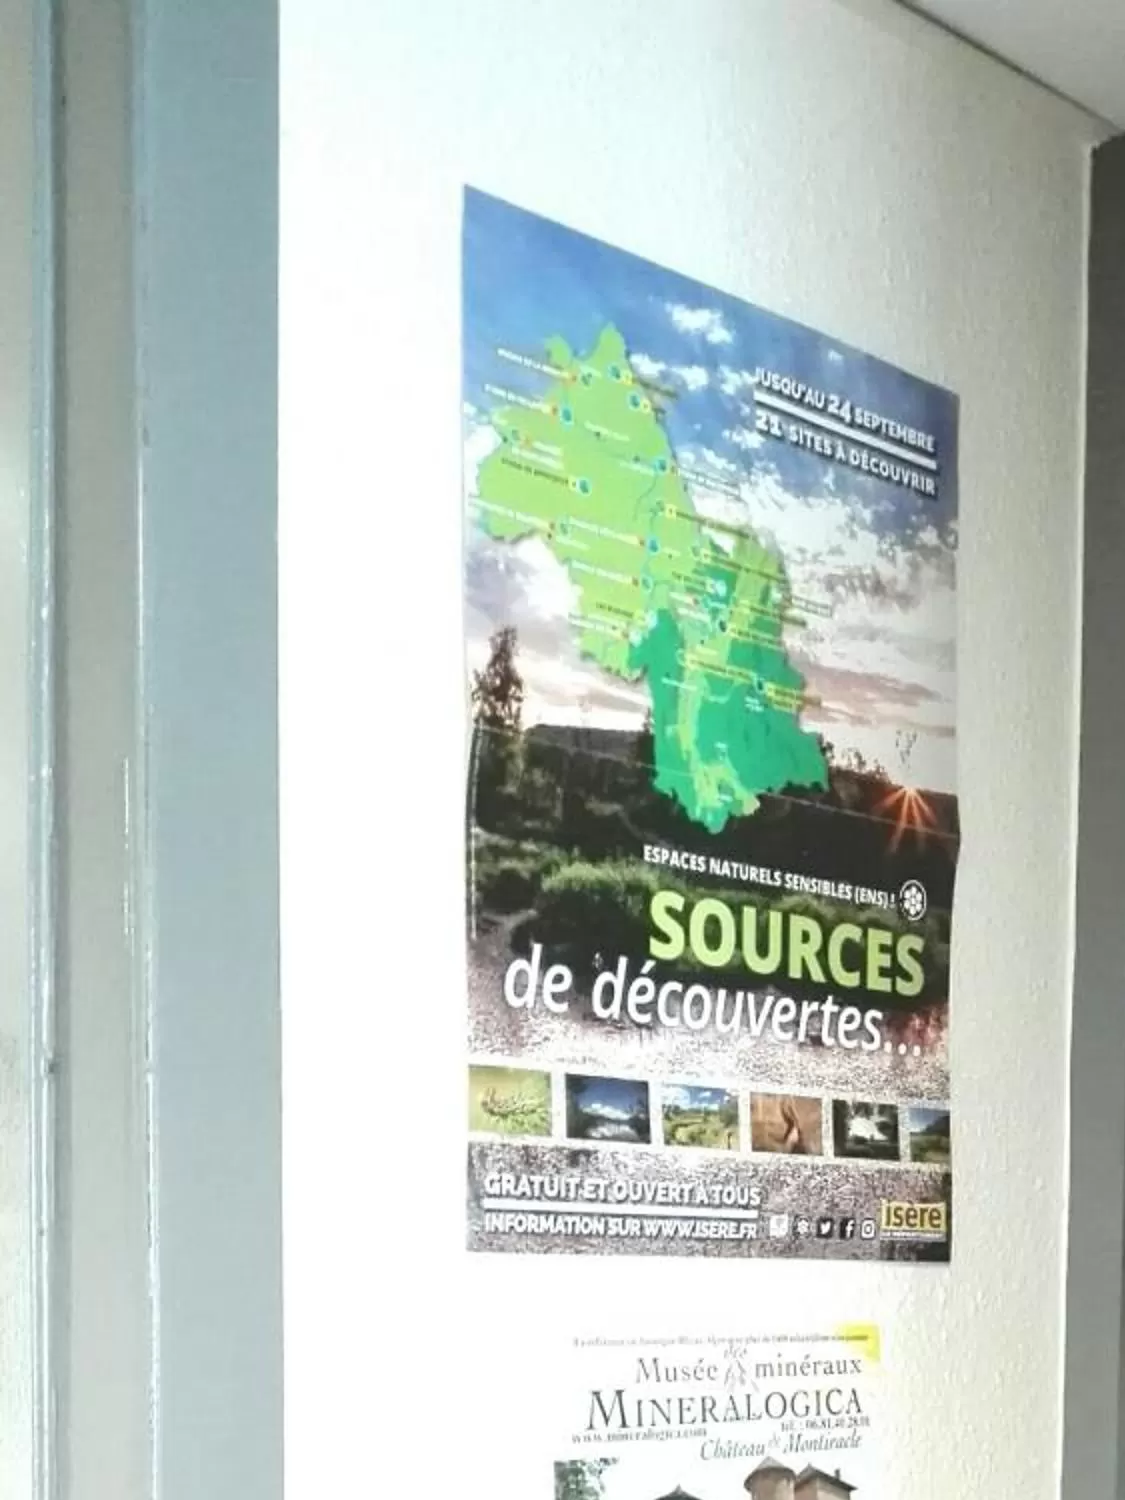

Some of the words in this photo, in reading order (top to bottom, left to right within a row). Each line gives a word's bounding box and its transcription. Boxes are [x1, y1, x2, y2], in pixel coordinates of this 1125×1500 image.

[753, 367, 825, 409] JUSQU'AU
[827, 394, 851, 423] 24
[854, 407, 936, 452] SEPTEMBRE
[755, 409, 783, 437] 21
[788, 425, 832, 455] SITES
[834, 439, 846, 461] À
[850, 449, 936, 495] DÉCOUVRIR
[643, 844, 707, 873] ESPACES
[709, 857, 783, 887] NATURELS
[784, 873, 853, 901] SENSIBLES
[855, 887, 888, 908] (ENS)
[648, 889, 925, 997] SOURCES
[504, 943, 573, 1014] de
[591, 956, 923, 1058] découvertes...
[484, 1173, 580, 1199] GRATUIT
[582, 1178, 609, 1201] ET
[613, 1180, 692, 1203] OUVERT
[713, 1185, 761, 1206] TOUS
[485, 1212, 605, 1235] INFORMATION
[608, 1217, 640, 1236] SUR
[636, 1357, 719, 1383] Musée
[755, 1352, 862, 1378] minéraux
[700, 1437, 765, 1460] Château
